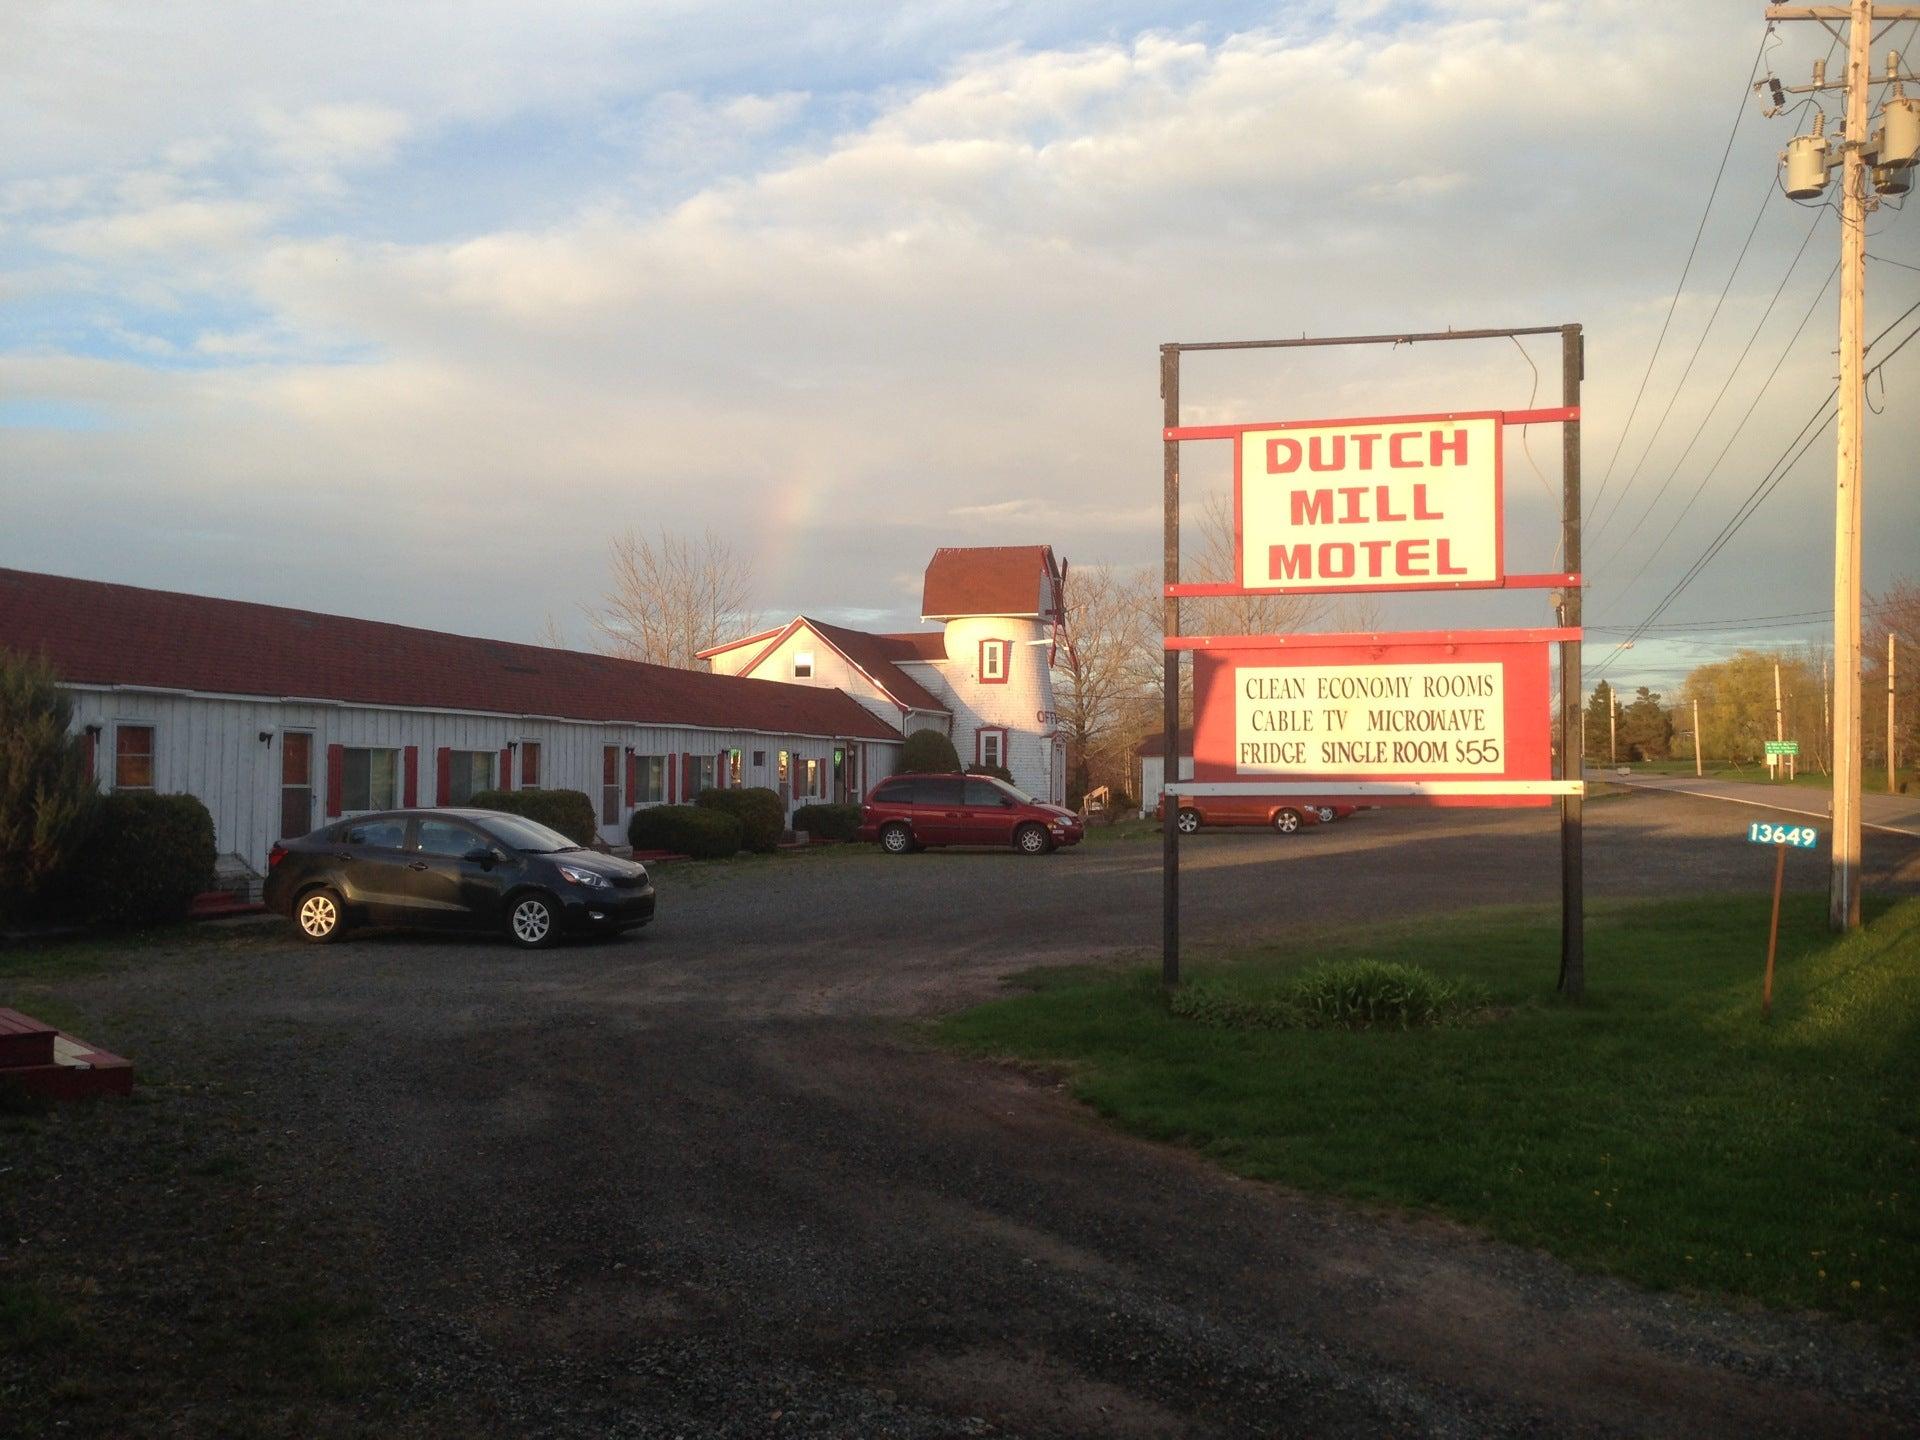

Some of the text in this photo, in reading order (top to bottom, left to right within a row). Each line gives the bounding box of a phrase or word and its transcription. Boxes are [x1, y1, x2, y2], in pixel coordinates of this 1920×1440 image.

[1266, 429, 1468, 475] DUTCH
[1290, 483, 1444, 526] MILL
[1268, 538, 1468, 580] MOTEL
[1245, 674, 1494, 700] CLEAN ECONOMY ROOMS
[1251, 708, 1486, 732] CABLE TV MICROWAVE
[1240, 738, 1500, 765] FRIDGE SINGLE ROOM $55
[1751, 823, 1815, 846] 13649
